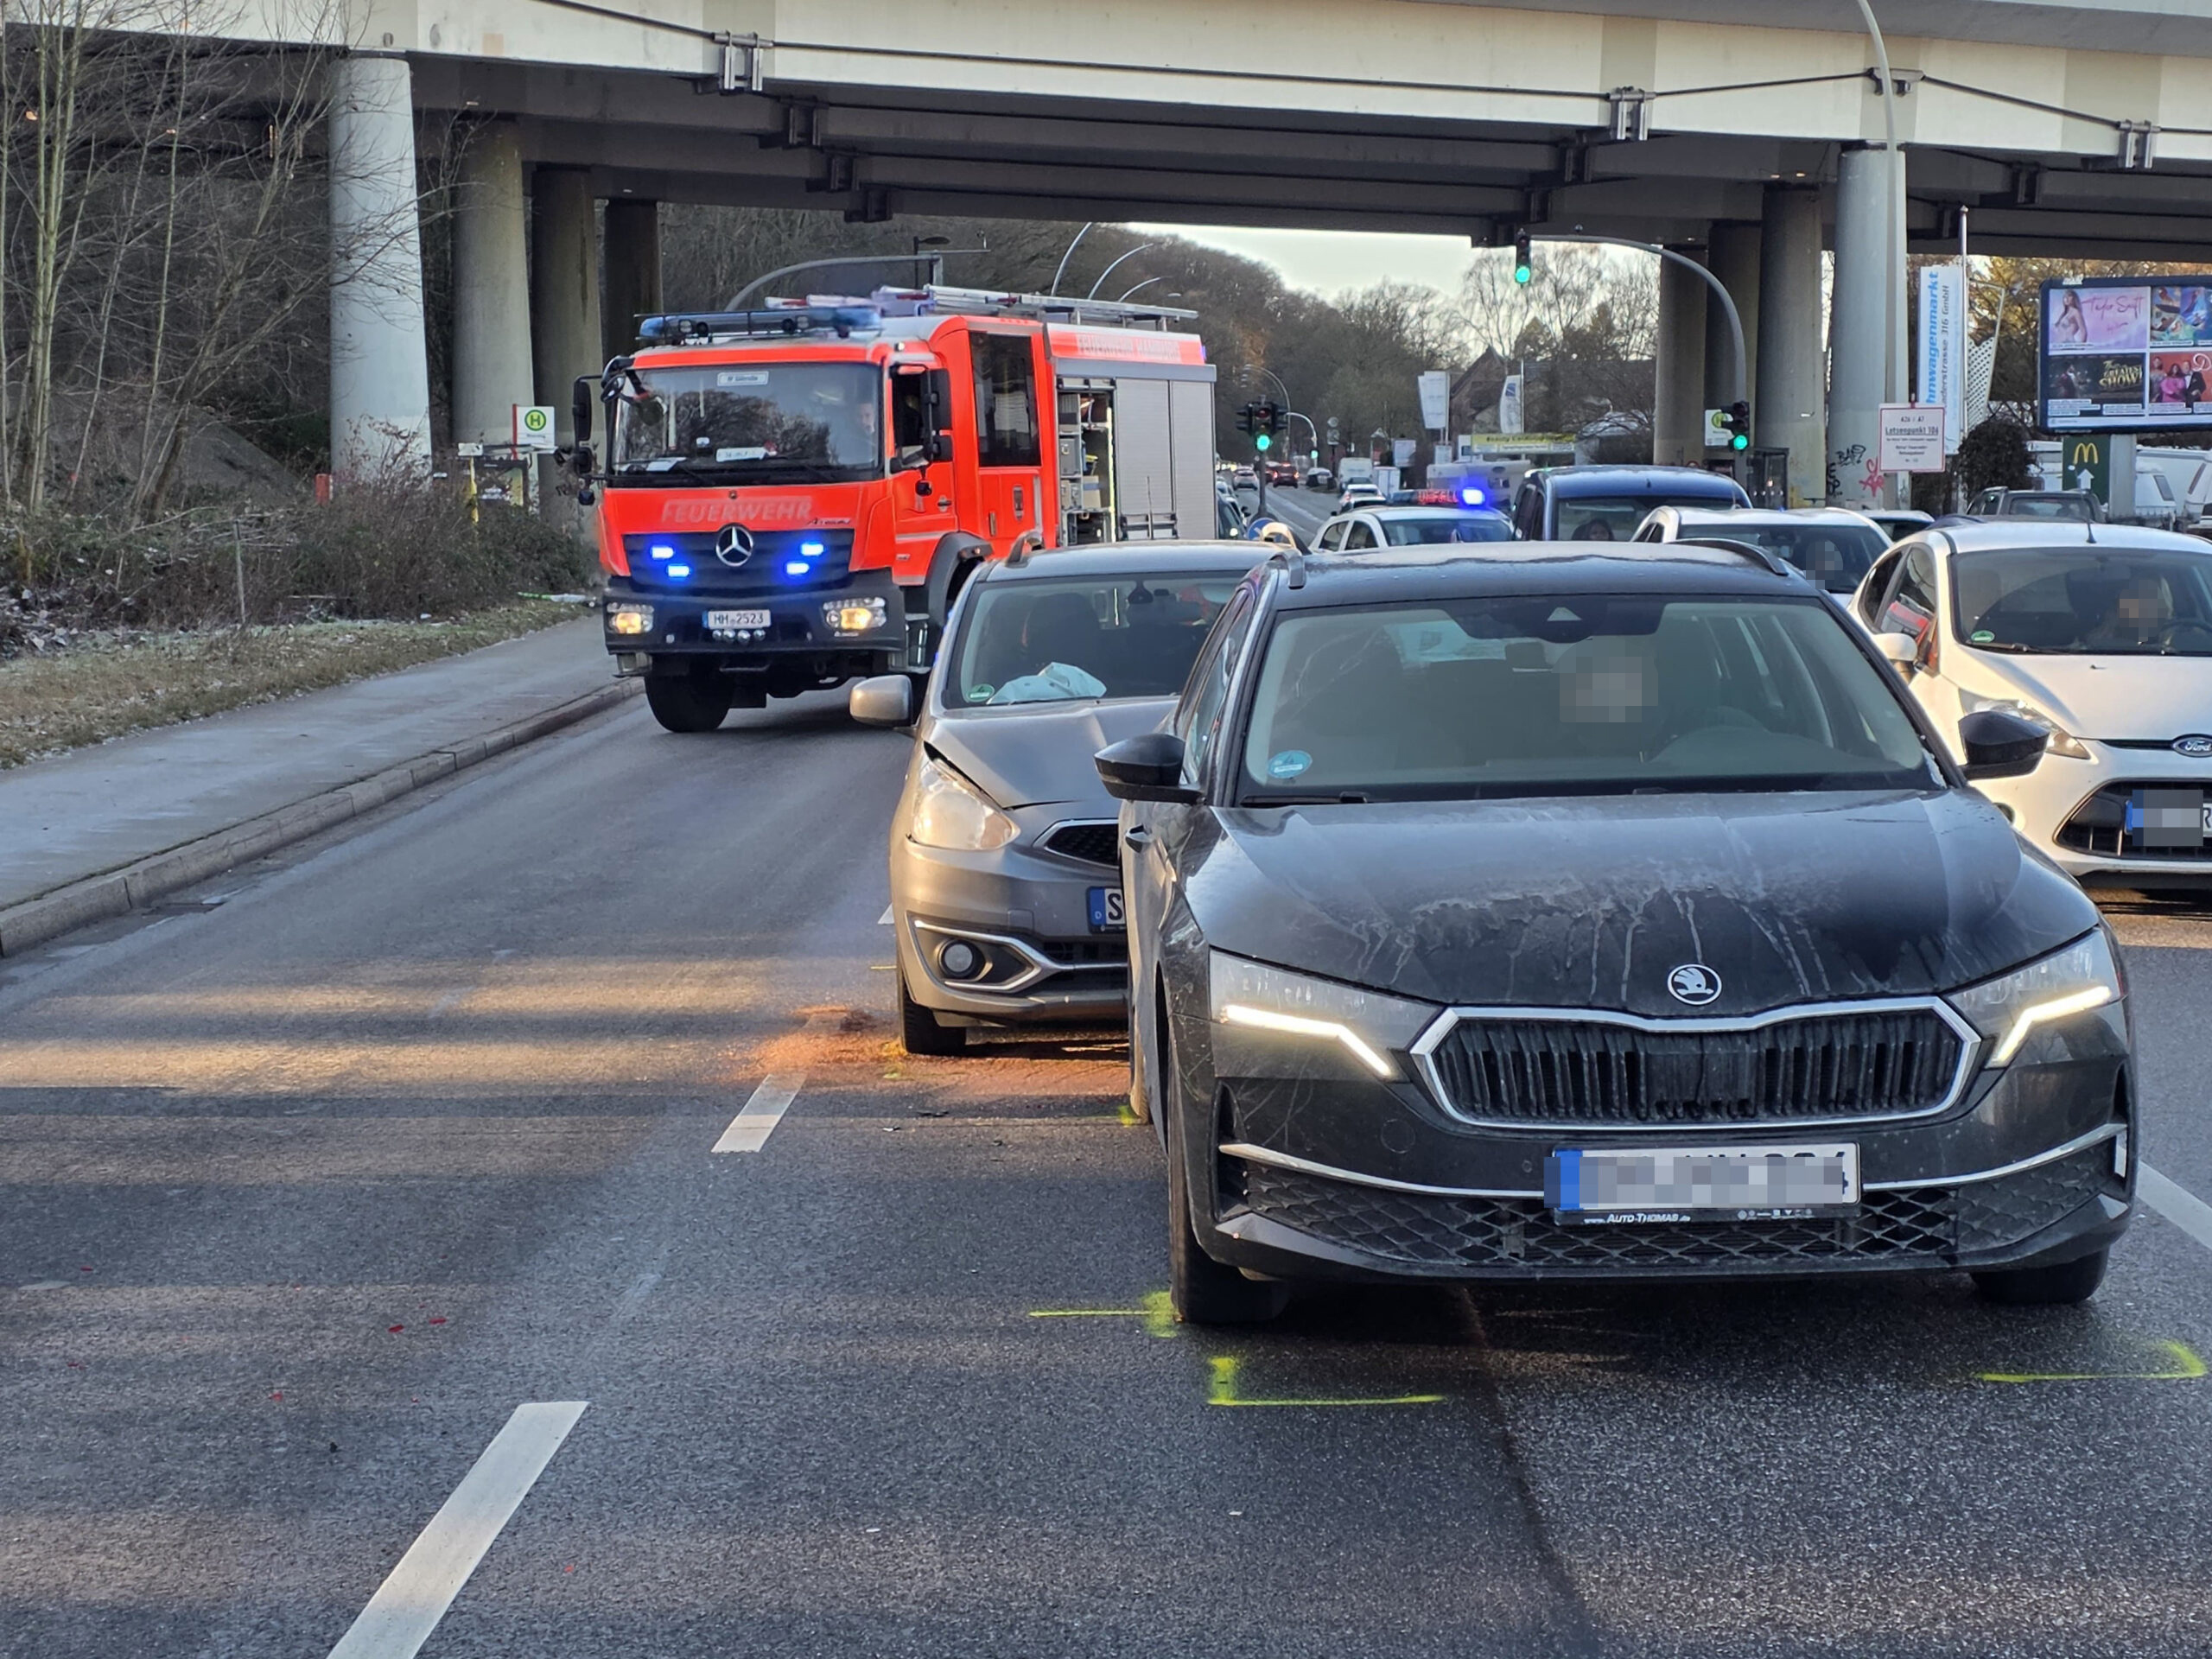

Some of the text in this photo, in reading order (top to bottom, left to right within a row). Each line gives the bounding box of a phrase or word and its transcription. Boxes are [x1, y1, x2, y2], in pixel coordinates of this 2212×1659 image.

[1926, 271, 1939, 404] hnwagenmarkt
[662, 495, 812, 523] FEUERWEHR
[2184, 740, 2212, 752] Ford
